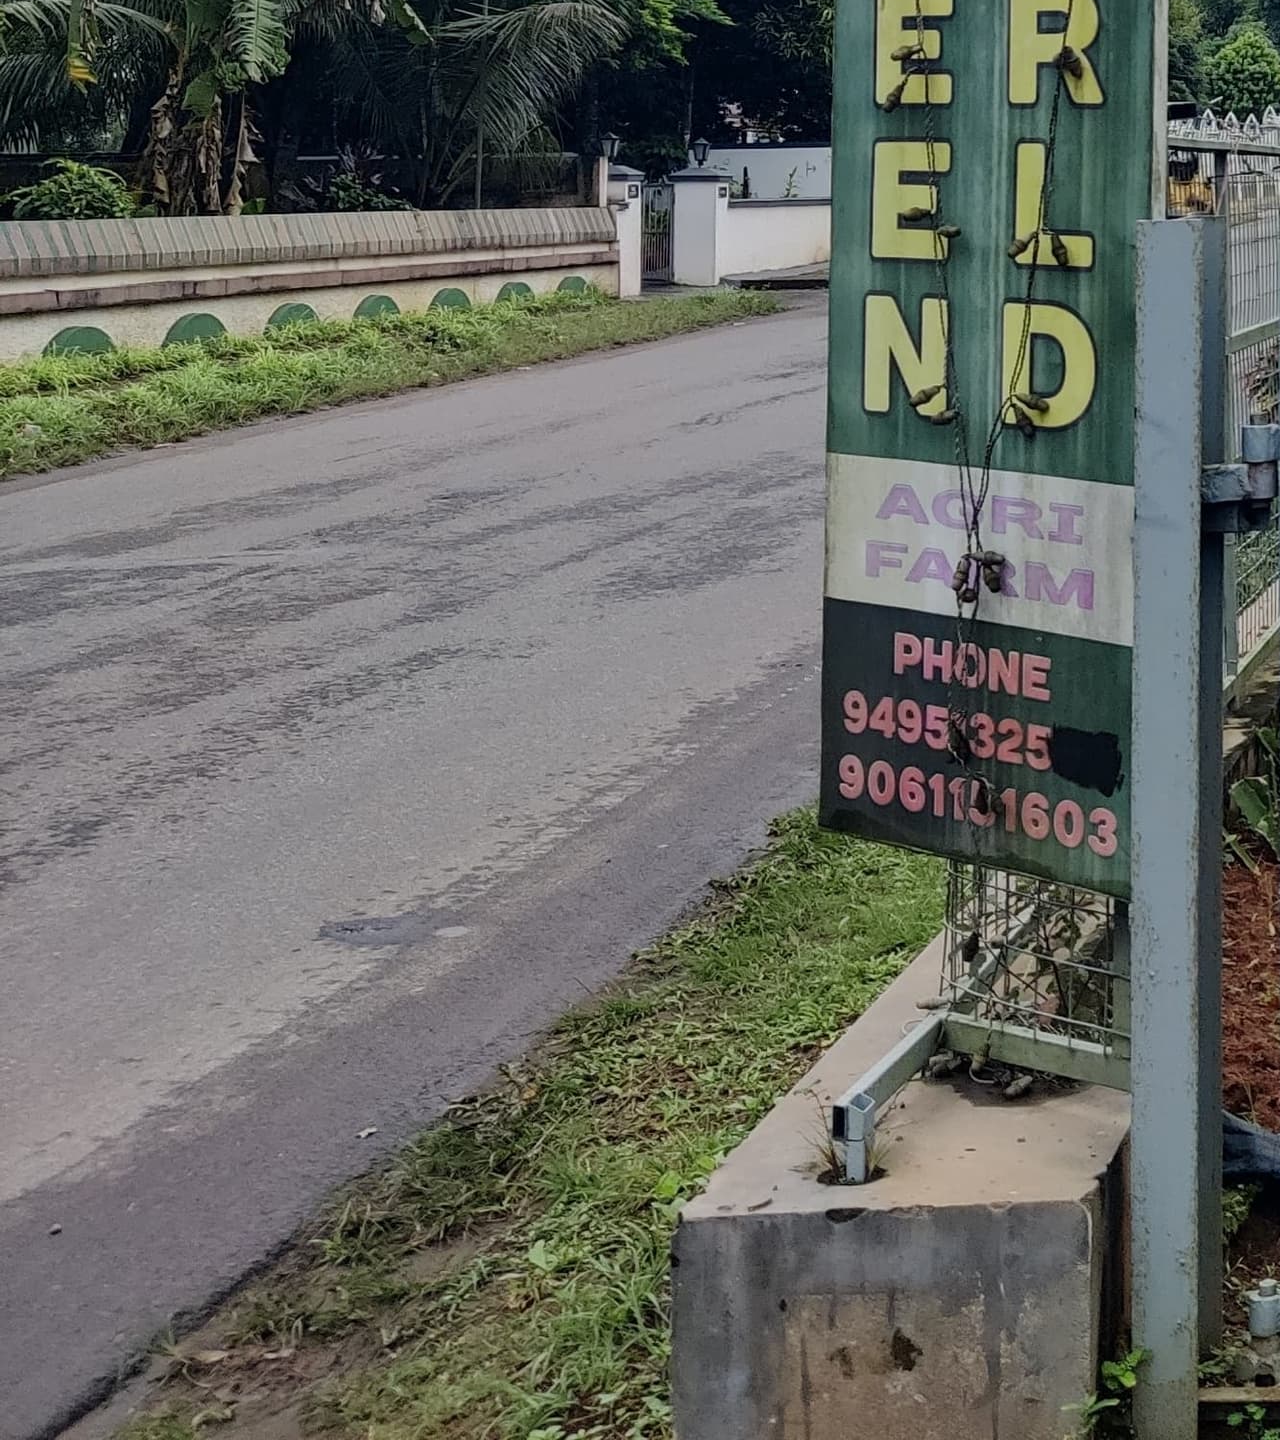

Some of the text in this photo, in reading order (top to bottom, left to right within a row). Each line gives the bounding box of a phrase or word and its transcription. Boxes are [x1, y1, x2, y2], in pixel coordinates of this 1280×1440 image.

[875, 483, 1084, 545] AGRI
[893, 632, 1052, 702] PHONE
[841, 689, 1122, 797] 9495325
